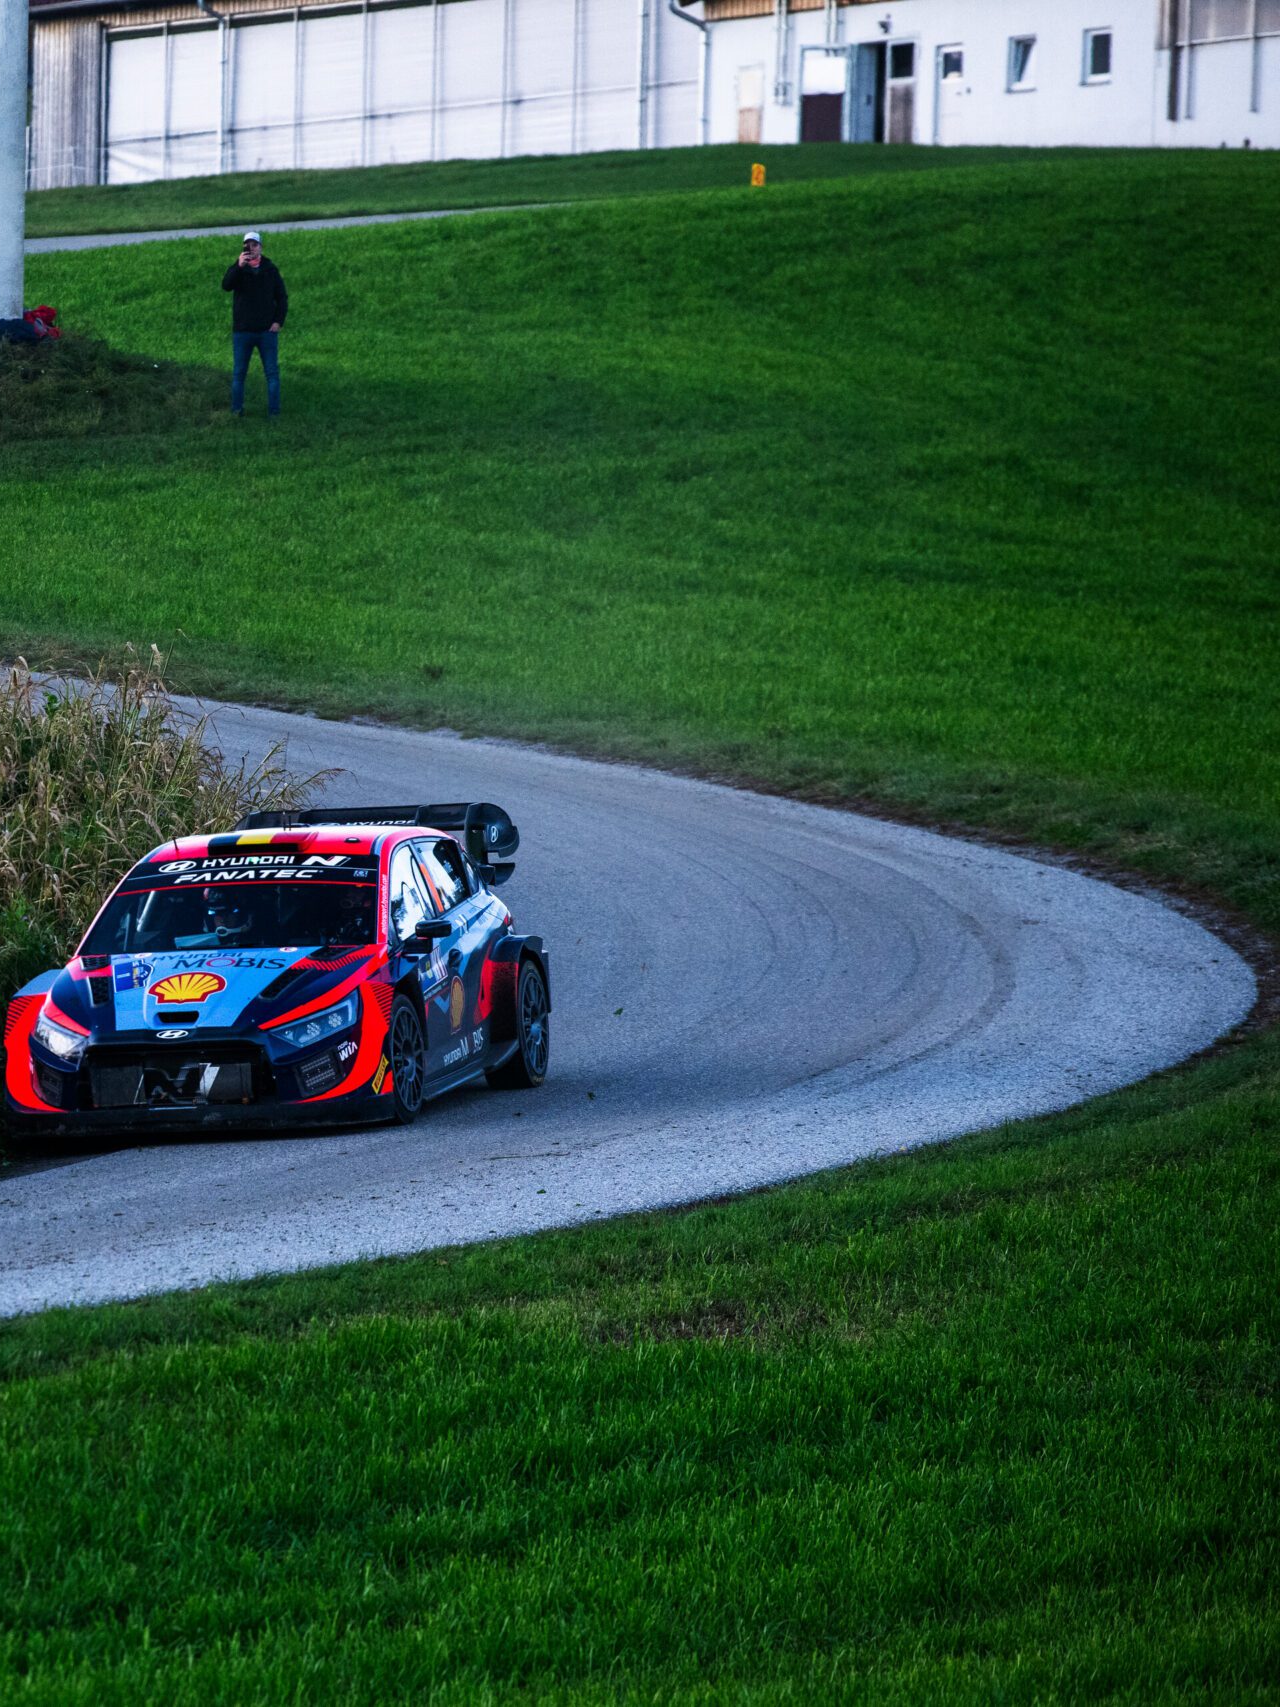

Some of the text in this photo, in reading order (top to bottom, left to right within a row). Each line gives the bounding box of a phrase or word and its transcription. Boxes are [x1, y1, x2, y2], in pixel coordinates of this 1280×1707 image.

[202, 855, 351, 868] HYUNDAI N
[173, 869, 319, 884] FANATEC
[151, 952, 243, 962] HYUNDAI
[172, 957, 287, 970] MOBIS
[460, 1027, 484, 1056] MBIS
